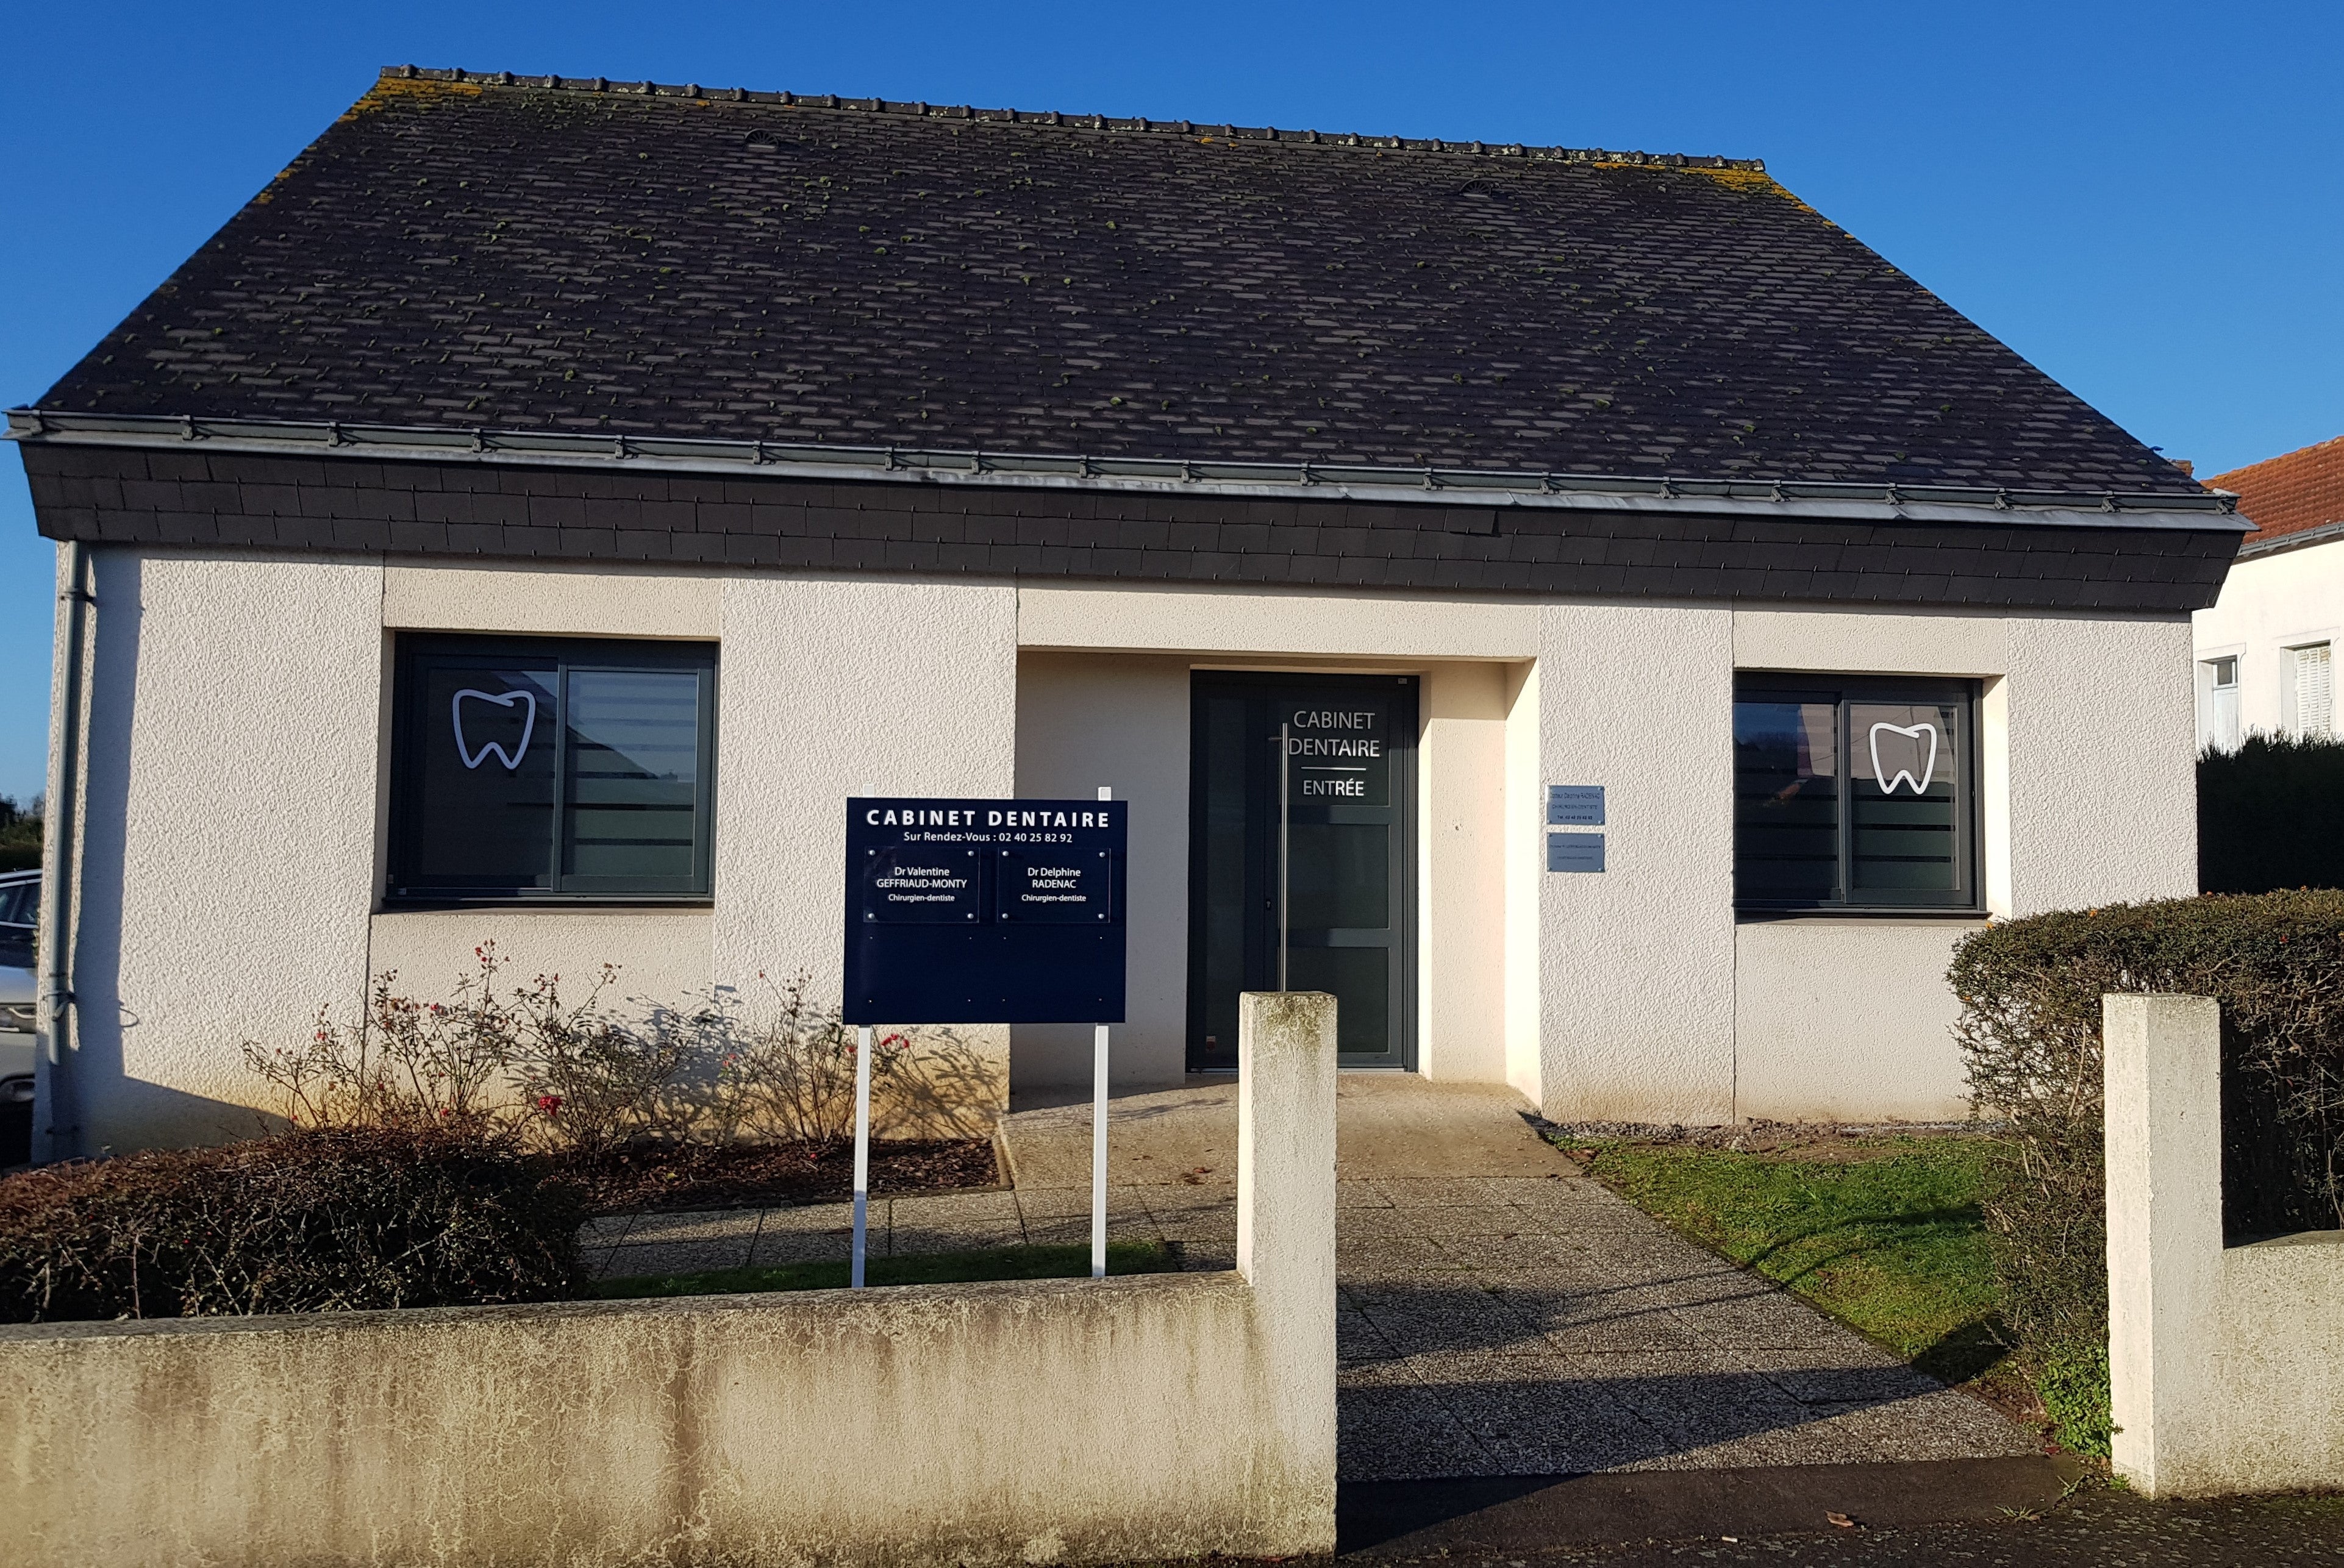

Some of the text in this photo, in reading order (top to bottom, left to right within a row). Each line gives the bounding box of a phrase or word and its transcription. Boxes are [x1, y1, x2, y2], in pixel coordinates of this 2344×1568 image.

[1293, 710, 1376, 729] CABINET
[1288, 738, 1381, 757] DENTAIRE
[1303, 777, 1365, 796] ENTRÉE
[866, 809, 1109, 827] CABINET DENTAIRE
[904, 832, 921, 841] Sur
[924, 832, 990, 842] Rendez-Vous
[999, 833, 1012, 842] 02
[1015, 833, 1027, 842] 40
[1029, 833, 1042, 843] 25
[1045, 833, 1057, 843] 82
[1060, 833, 1073, 843] 92
[895, 866, 950, 876] Dr Valentine
[1027, 867, 1081, 878] Dr Delphine
[876, 878, 968, 889] GEFFRIAUD-MONTY
[1032, 879, 1077, 889] RADENAC
[888, 893, 956, 903] Chirurgien-dentiste
[1021, 894, 1087, 903] Chirurgien-dentiste
